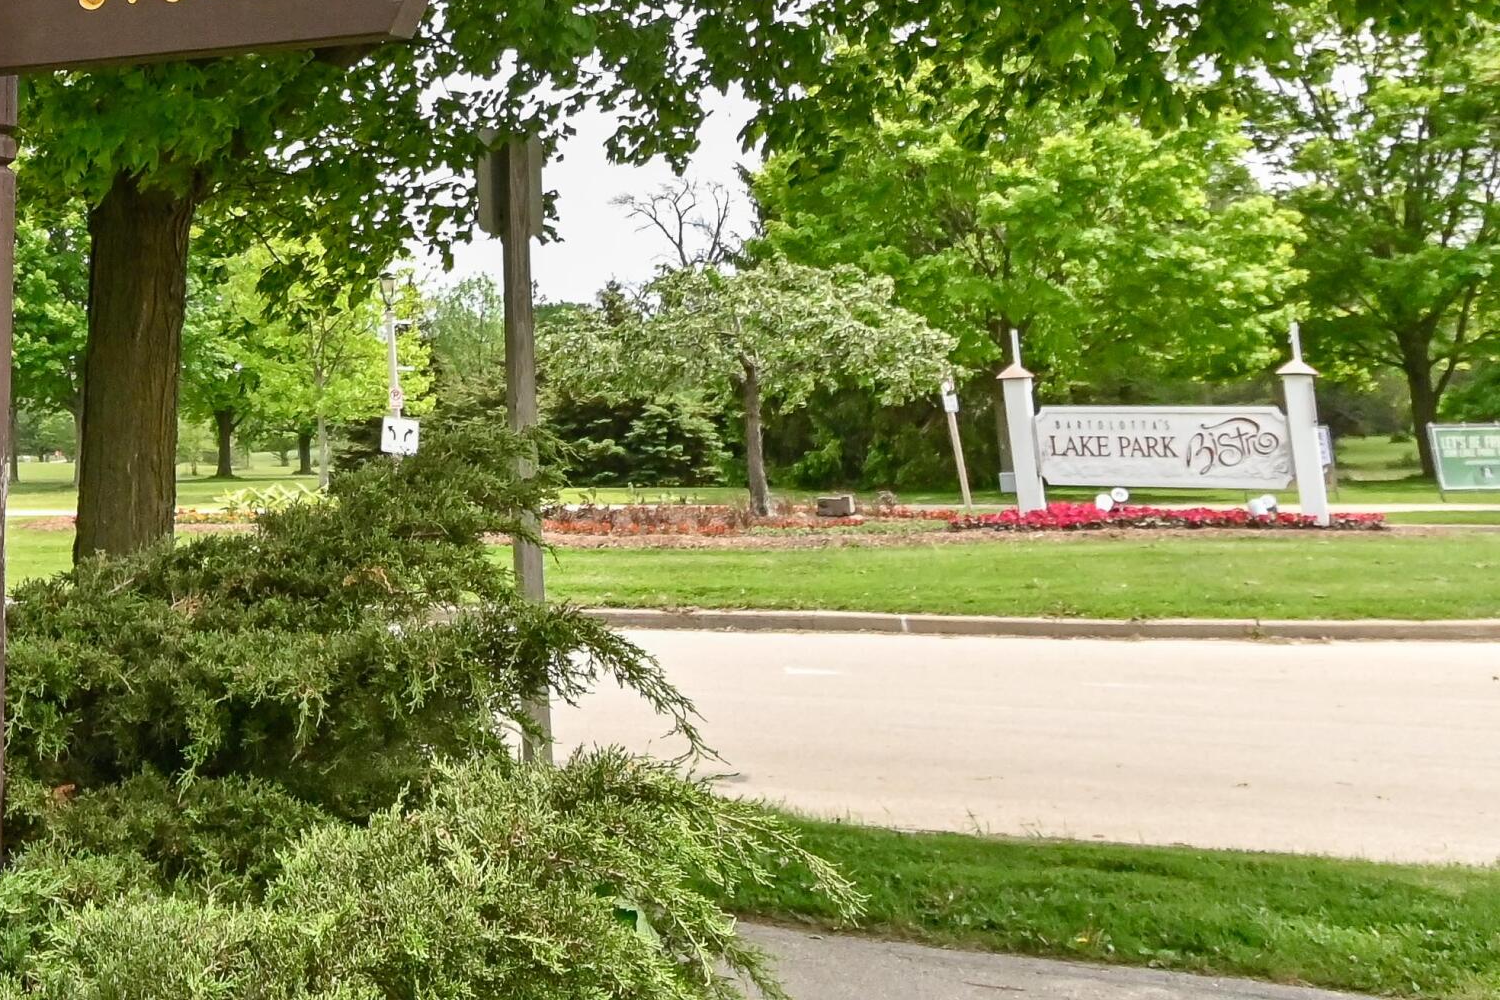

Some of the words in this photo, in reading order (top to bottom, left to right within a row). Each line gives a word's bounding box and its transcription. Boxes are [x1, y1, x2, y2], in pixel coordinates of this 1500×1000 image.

[1049, 435, 1111, 457] LAKE
[1118, 436, 1179, 457] PARK
[1186, 416, 1280, 475] Bistro
